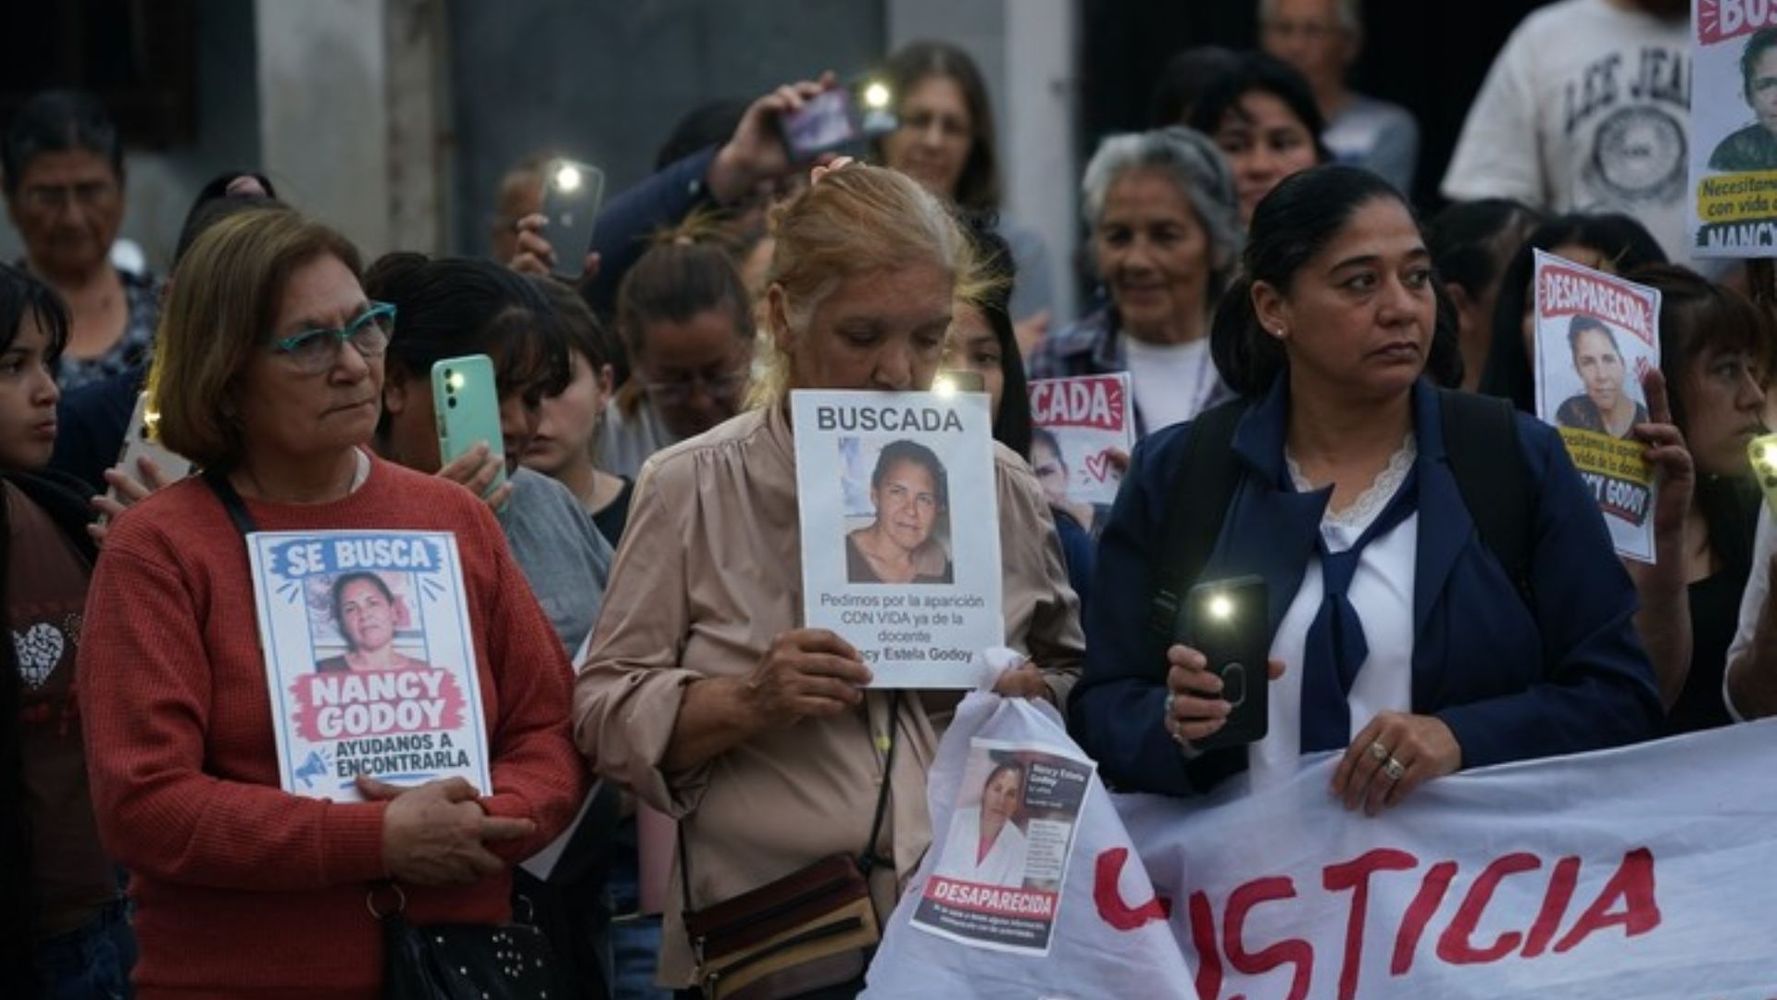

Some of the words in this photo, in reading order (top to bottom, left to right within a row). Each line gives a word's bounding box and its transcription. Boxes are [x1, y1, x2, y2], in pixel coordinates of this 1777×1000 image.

[1564, 52, 1622, 135] LEE
[1631, 47, 1693, 114] JEA
[1707, 202, 1734, 217] con
[1738, 194, 1768, 212] vida
[1544, 271, 1646, 332] DESAPARECIDA
[1029, 381, 1112, 426] CADA
[816, 406, 965, 432] BUSCADA
[286, 542, 325, 575] SE
[334, 538, 432, 569] BUSCA
[820, 593, 880, 607] Pedimos
[883, 596, 904, 609] por
[908, 593, 921, 607] la
[924, 593, 985, 610] aparición
[841, 611, 874, 625] CON
[877, 611, 911, 625] VIDA
[914, 614, 929, 628] ya
[932, 611, 948, 625] de
[952, 611, 963, 625] la
[878, 630, 931, 642] docente
[884, 648, 926, 661] Estela
[929, 648, 973, 663] Godoy
[311, 671, 445, 706] NANCY
[316, 699, 446, 738] GODOY
[336, 733, 434, 758] AYUDANOS
[440, 732, 454, 748] A
[336, 749, 471, 777] ENCONTRARLA
[933, 881, 1051, 916] DESAPARECIDA
